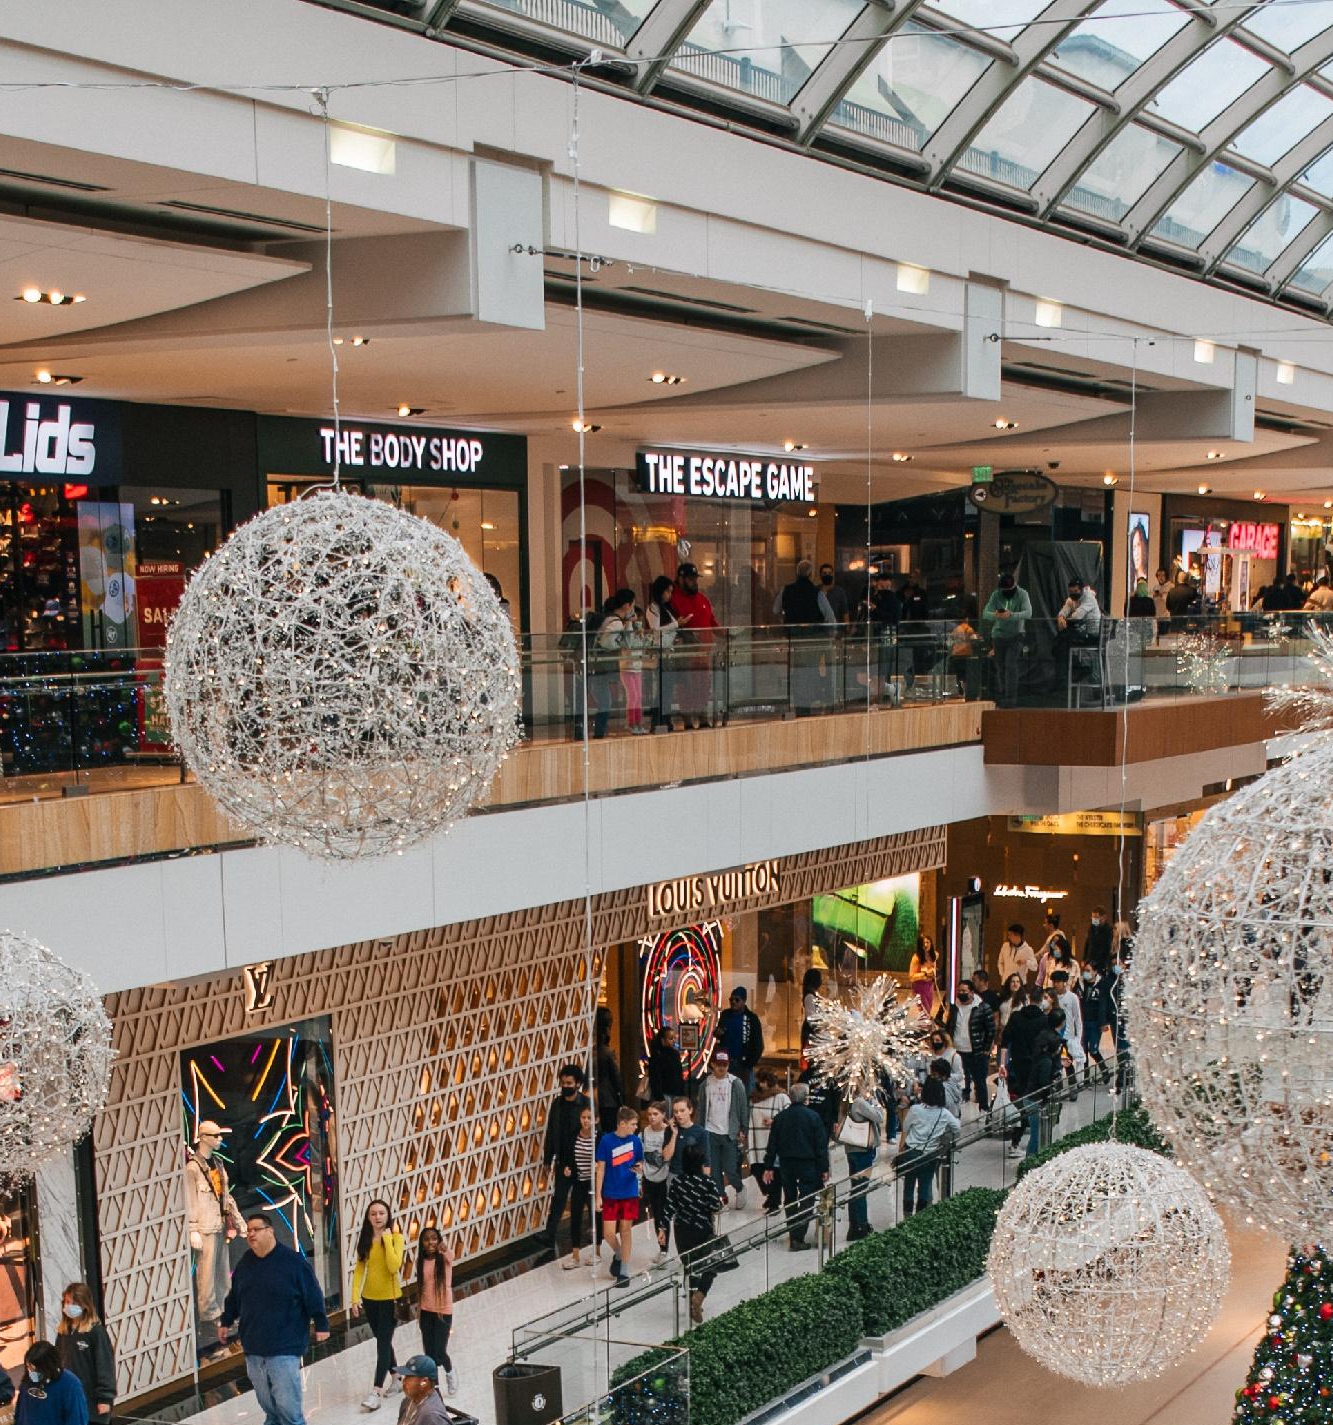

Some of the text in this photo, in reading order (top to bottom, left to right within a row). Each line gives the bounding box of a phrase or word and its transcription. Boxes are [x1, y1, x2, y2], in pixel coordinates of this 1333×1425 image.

[319, 428, 483, 472] THE BODY SHOP
[645, 454, 815, 501] THE ESCAPE GAME
[1228, 523, 1279, 560] GARAGE
[139, 564, 179, 573] NOW HIRING
[648, 860, 781, 918] LOUIS VUITTON
